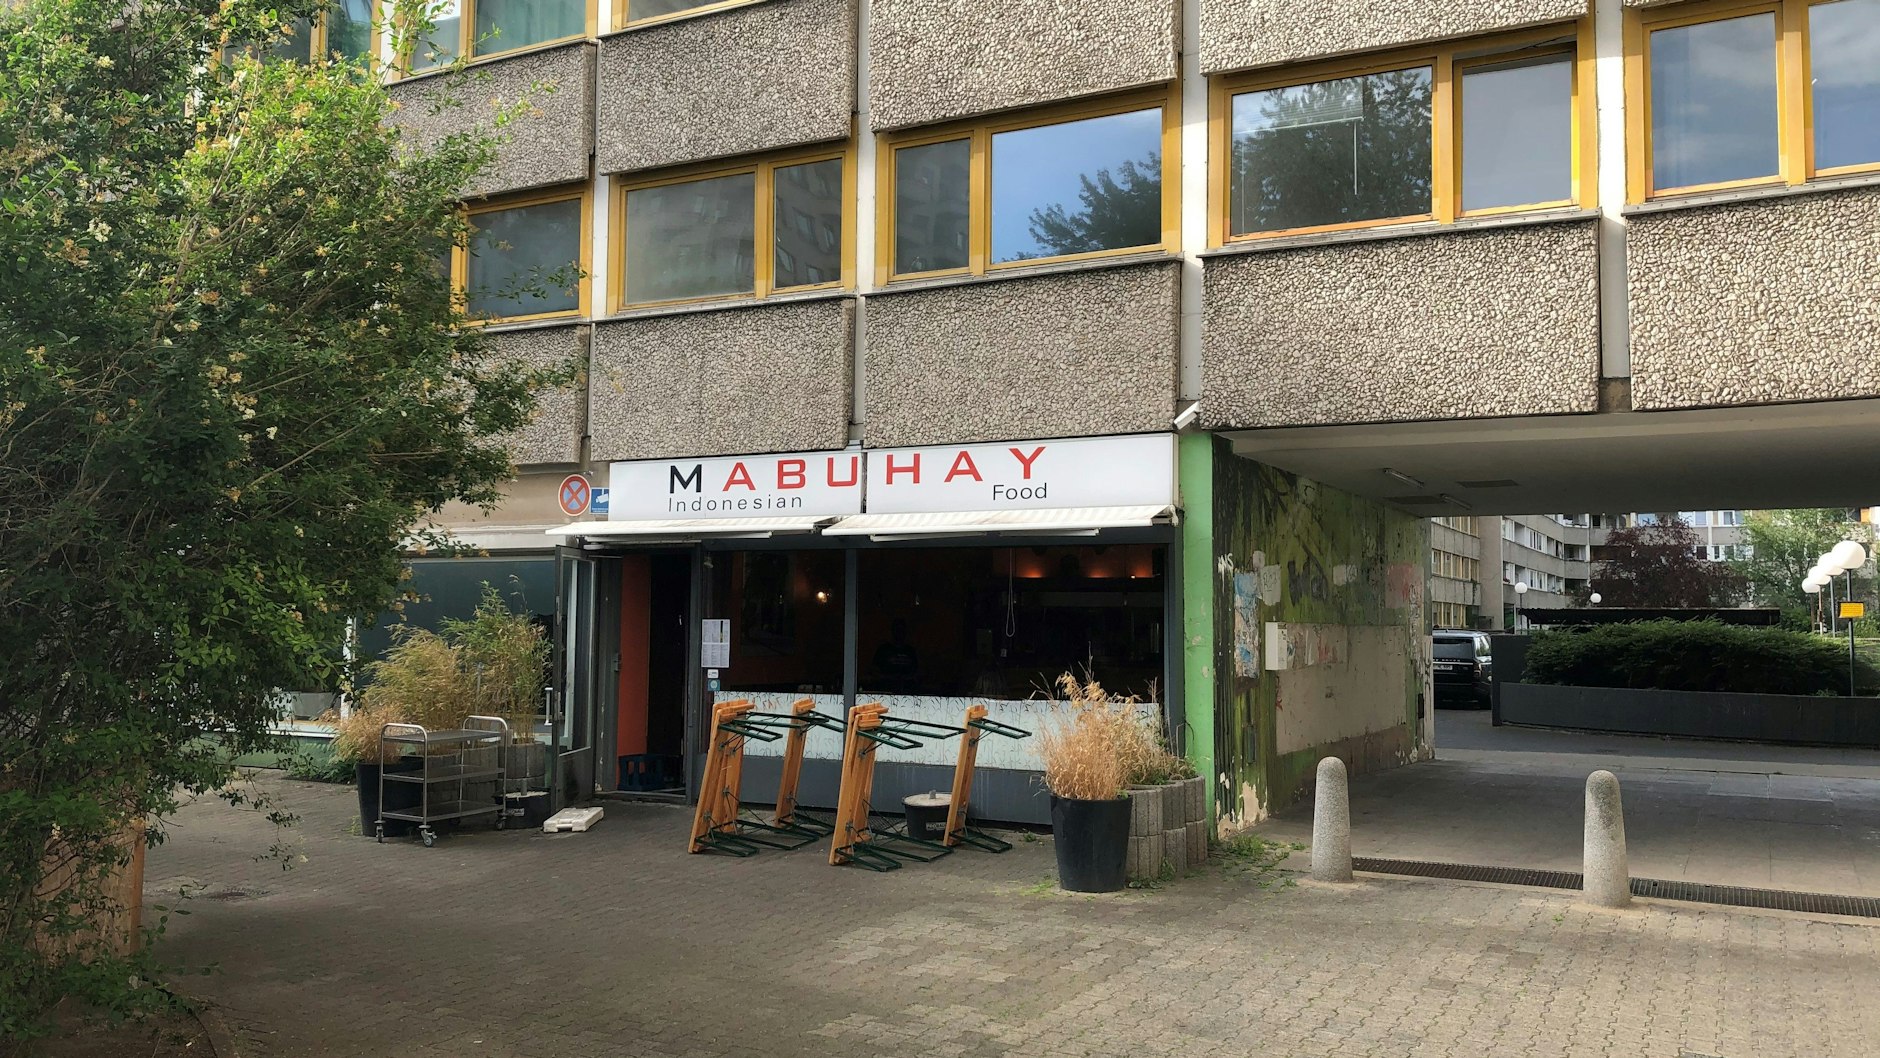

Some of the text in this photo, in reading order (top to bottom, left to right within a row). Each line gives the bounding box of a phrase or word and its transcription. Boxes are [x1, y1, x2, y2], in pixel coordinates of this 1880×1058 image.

[669, 446, 1046, 494] MABUHAY
[668, 482, 1047, 512] Indonesian Food
